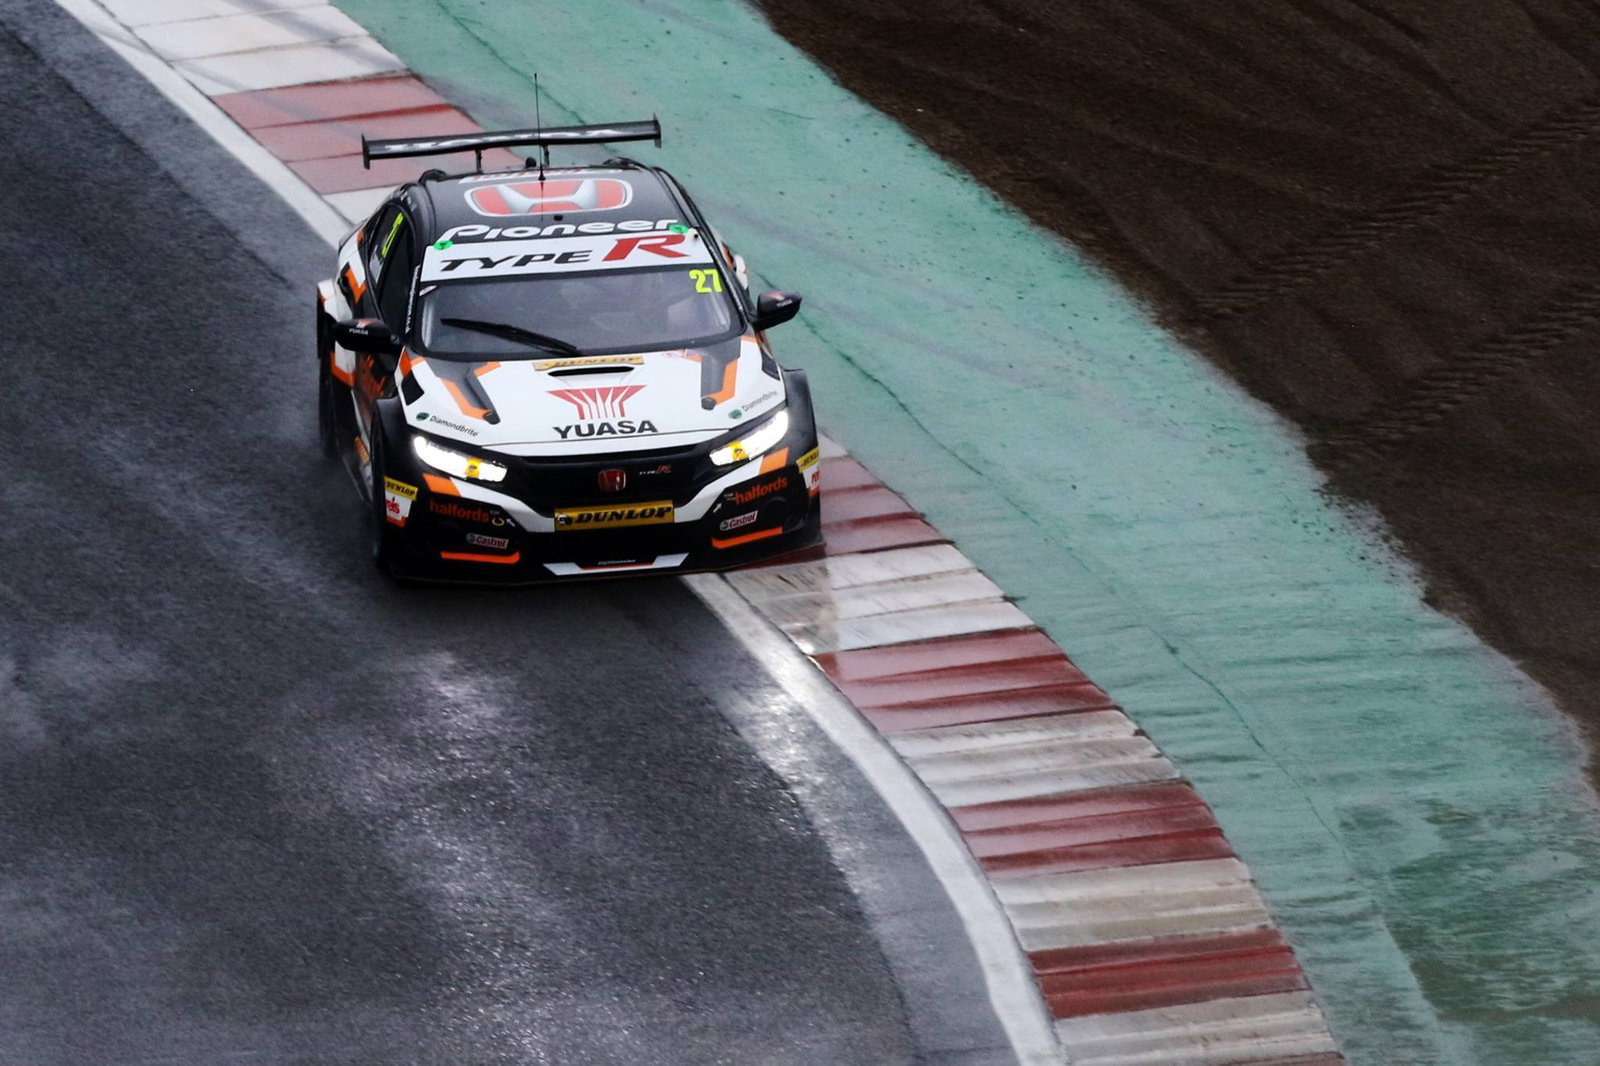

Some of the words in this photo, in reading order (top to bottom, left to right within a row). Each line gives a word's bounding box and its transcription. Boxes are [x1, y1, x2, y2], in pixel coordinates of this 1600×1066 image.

[435, 219, 678, 241] Pioneer
[440, 250, 593, 272] TYPE
[602, 234, 690, 262] R
[689, 268, 723, 293] 27
[429, 415, 479, 437] Diamondbrite
[553, 419, 658, 439] YUASA
[386, 480, 415, 497] DUNLOP
[735, 477, 788, 504] halfords
[429, 499, 490, 522] halfords
[575, 506, 672, 524] DUNLOP
[729, 512, 756, 528] Castrol
[476, 535, 506, 548] Castrol
